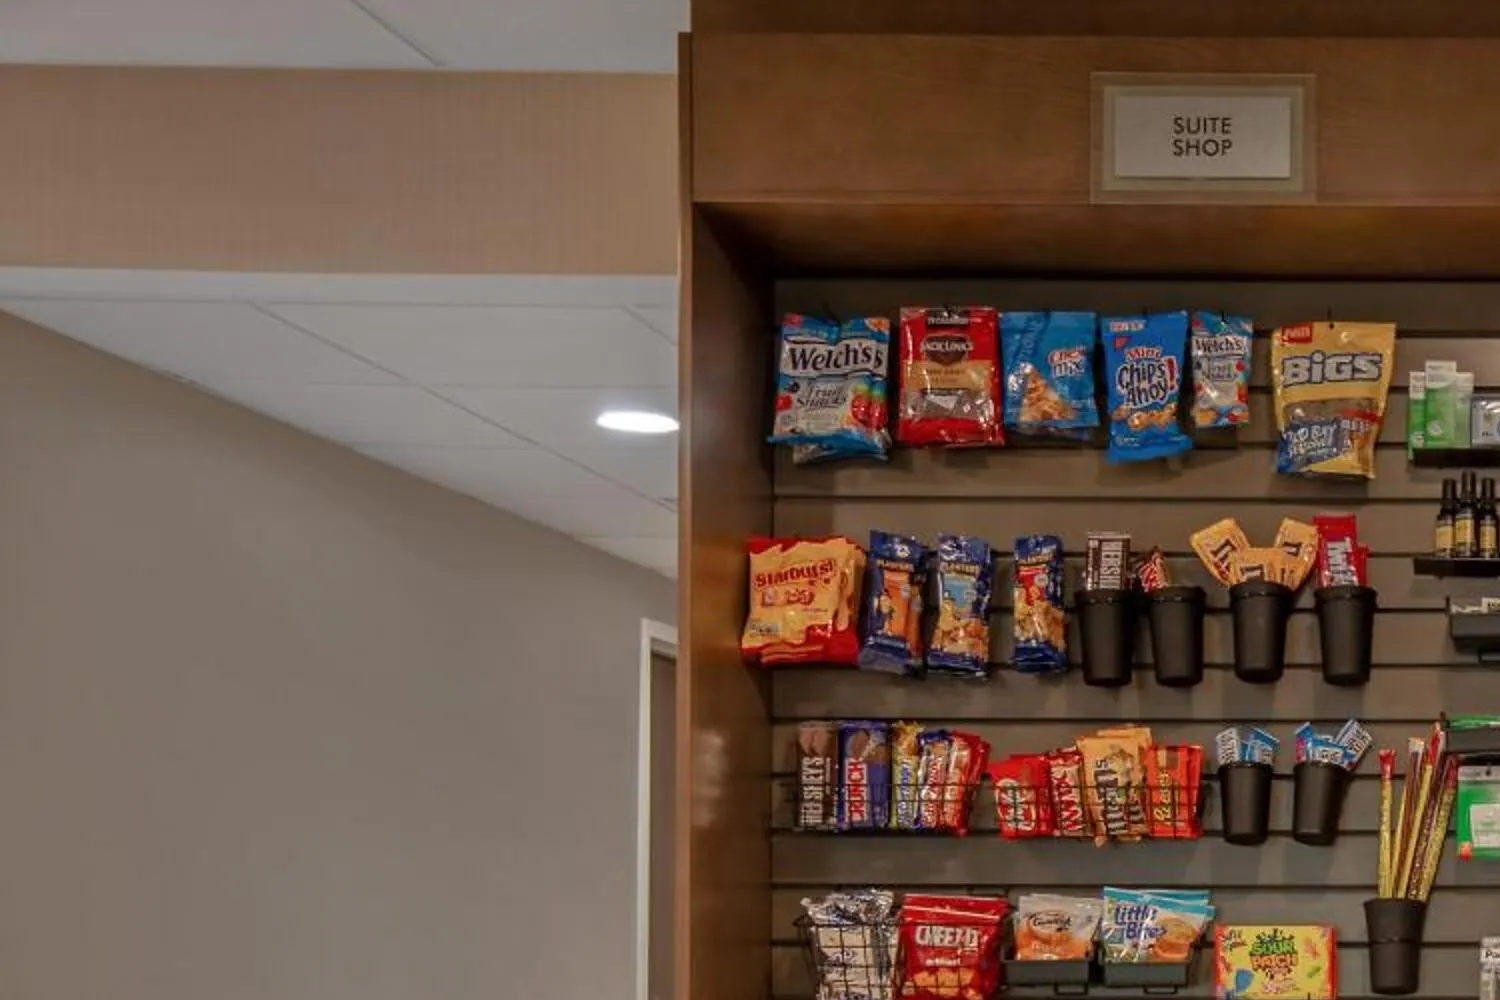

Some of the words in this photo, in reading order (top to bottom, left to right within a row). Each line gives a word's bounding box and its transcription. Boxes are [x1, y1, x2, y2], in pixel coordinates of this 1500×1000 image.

[1173, 116, 1232, 135] SUITE
[1173, 138, 1232, 157] SHOP
[1117, 360, 1166, 390] Chips
